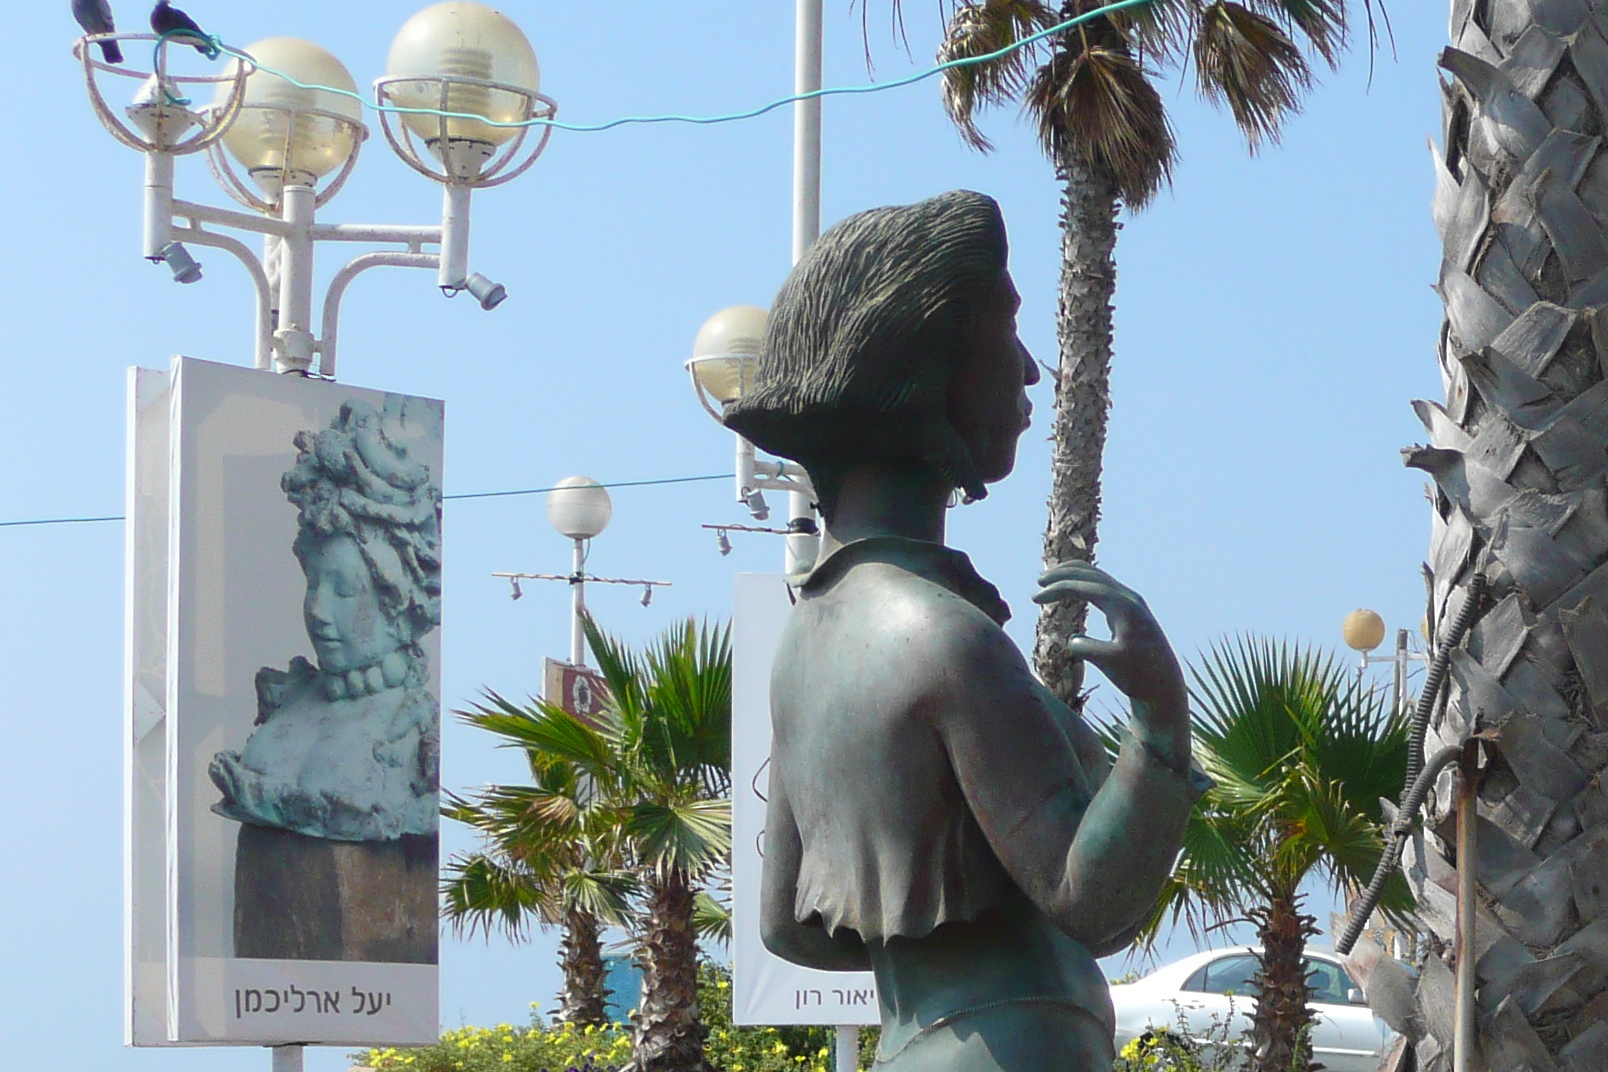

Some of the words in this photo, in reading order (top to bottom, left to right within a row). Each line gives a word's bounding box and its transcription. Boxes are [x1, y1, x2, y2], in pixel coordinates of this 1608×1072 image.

[235, 984, 341, 1019] ארליכמן
[351, 985, 391, 1016] יעל
[796, 989, 822, 1010] רון
[832, 989, 874, 1005] יאור
